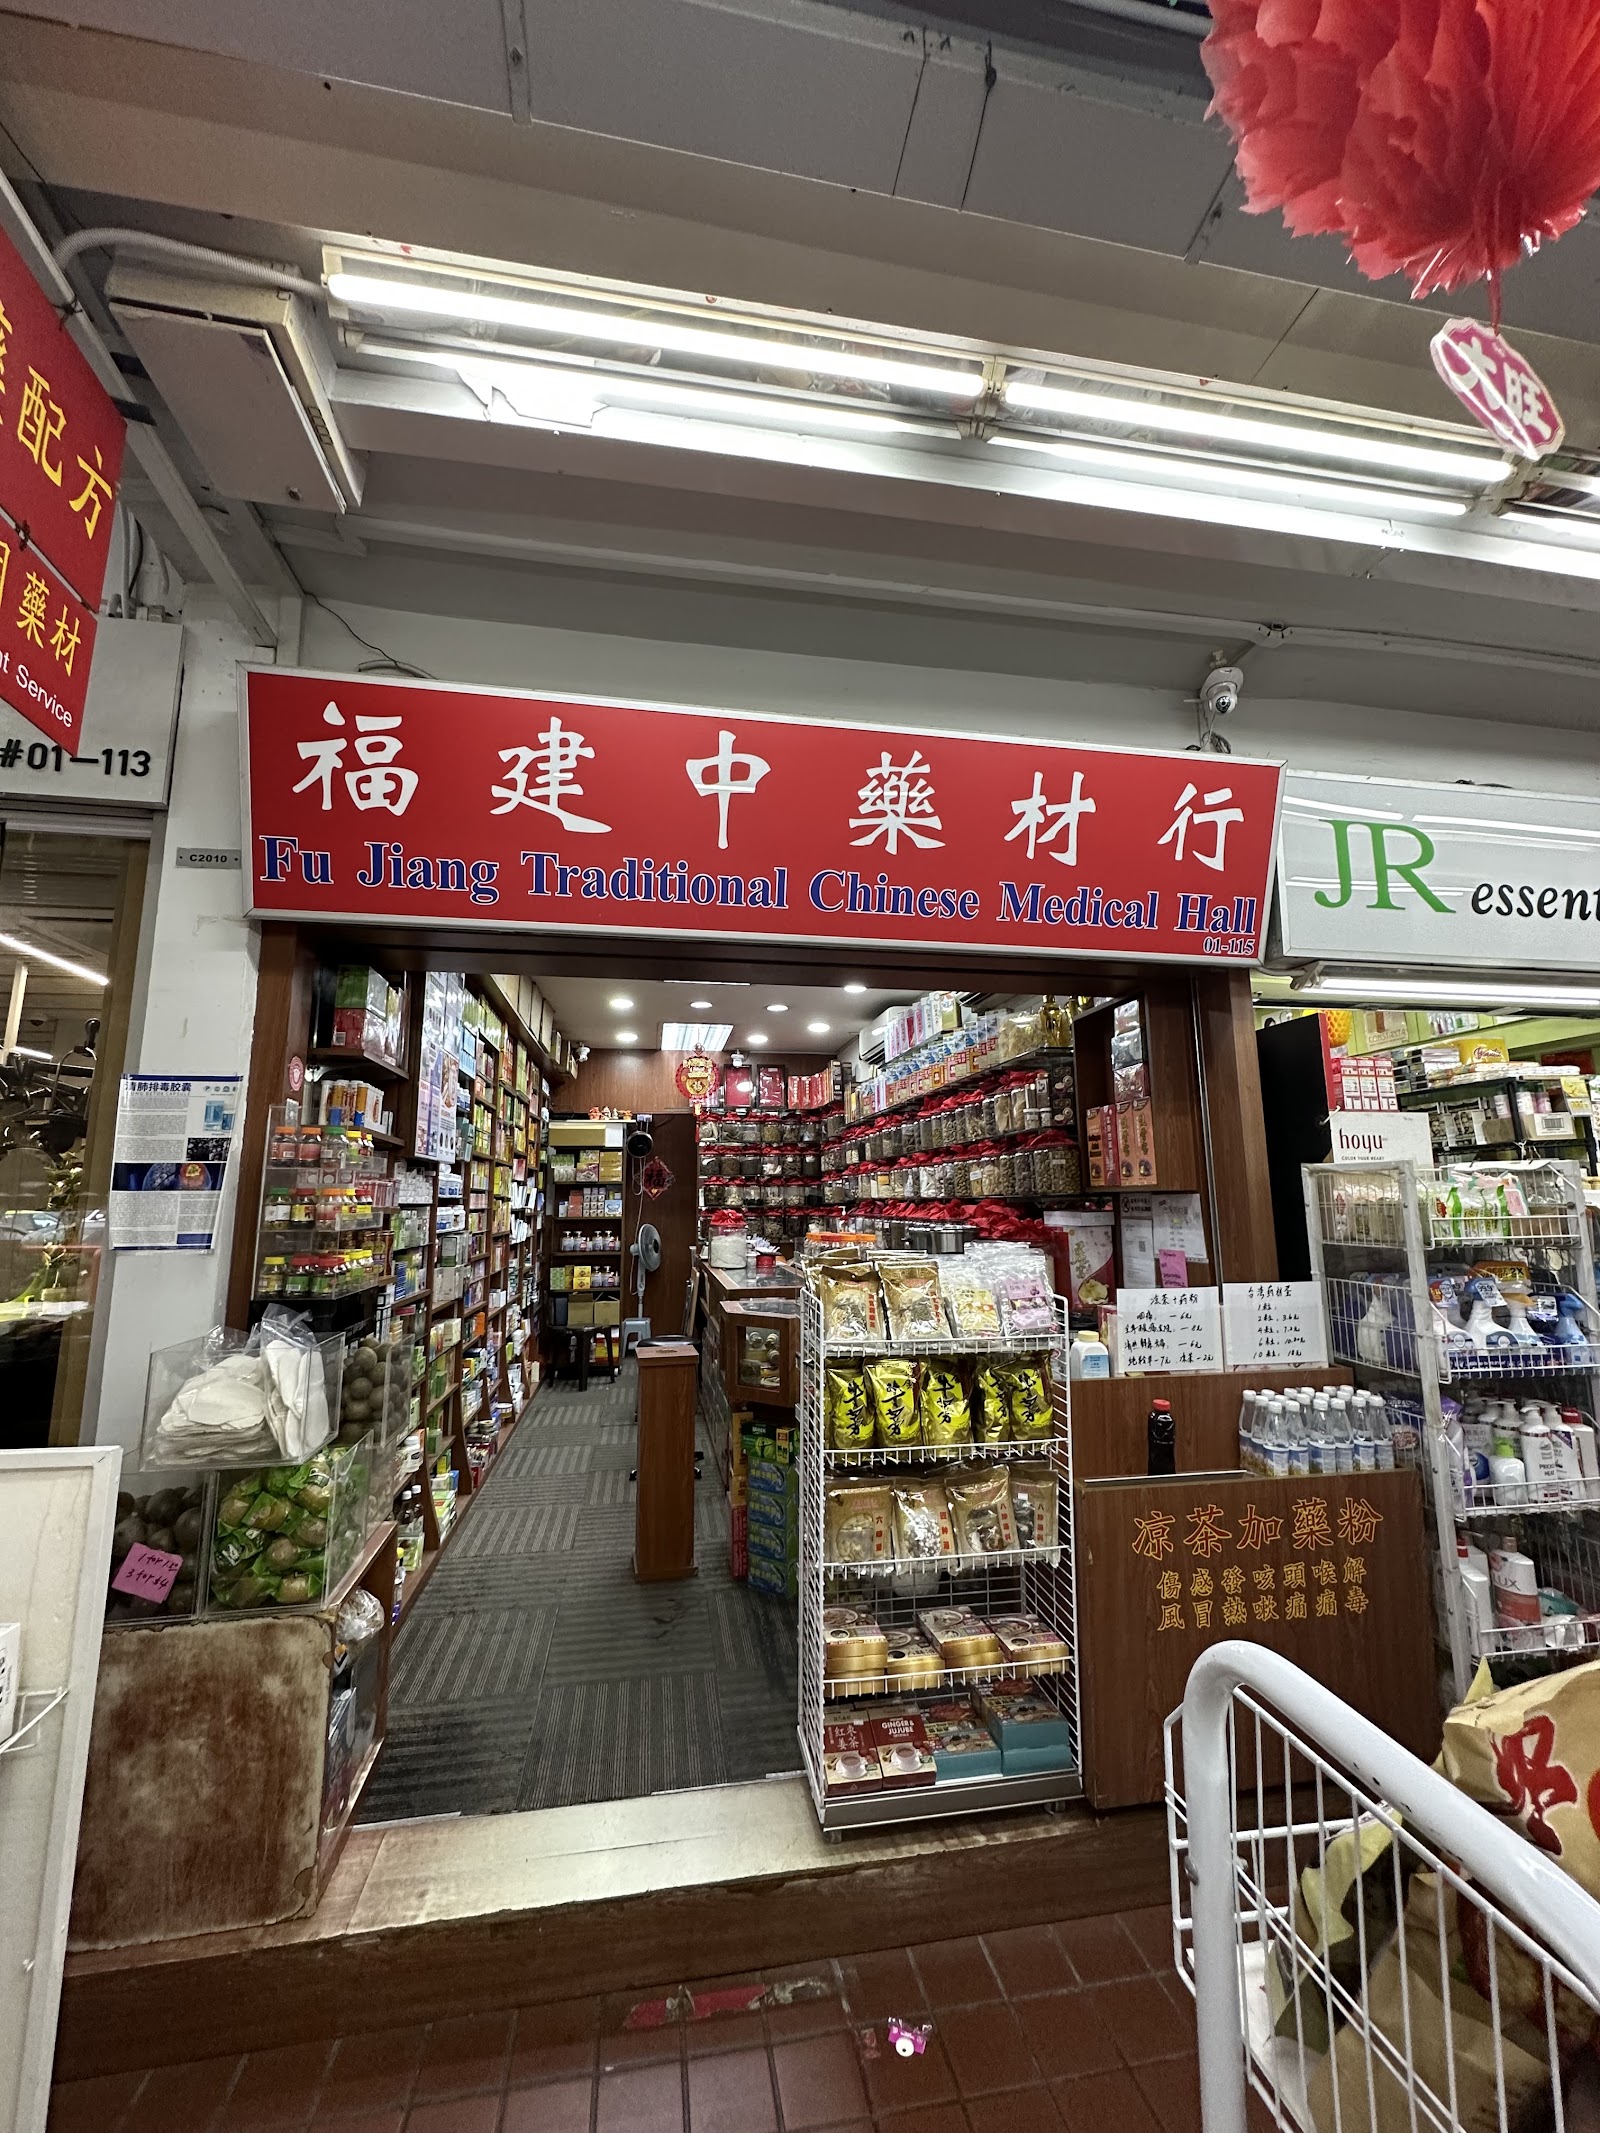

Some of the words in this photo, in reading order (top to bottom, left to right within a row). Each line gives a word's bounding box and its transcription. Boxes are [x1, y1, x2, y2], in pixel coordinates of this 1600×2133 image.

[15, 664, 73, 728] Service
[292, 701, 1244, 872] 福建中藥材行
[189, 854, 227, 863] C2010
[1314, 819, 1457, 914] JR
[258, 834, 333, 885] Fu
[358, 841, 500, 905] Jiang
[521, 851, 788, 909] Traditional
[808, 868, 980, 920] Chinese
[996, 881, 1160, 930] Medical
[1174, 893, 1257, 935] Hall
[1202, 936, 1255, 955] 01-115
[1339, 1127, 1383, 1154] hoyu
[1132, 1497, 1384, 1561] 凉茶加藥粉
[126, 1568, 135, 1578] 3
[136, 1569, 154, 1584] for
[146, 1555, 163, 1565] for
